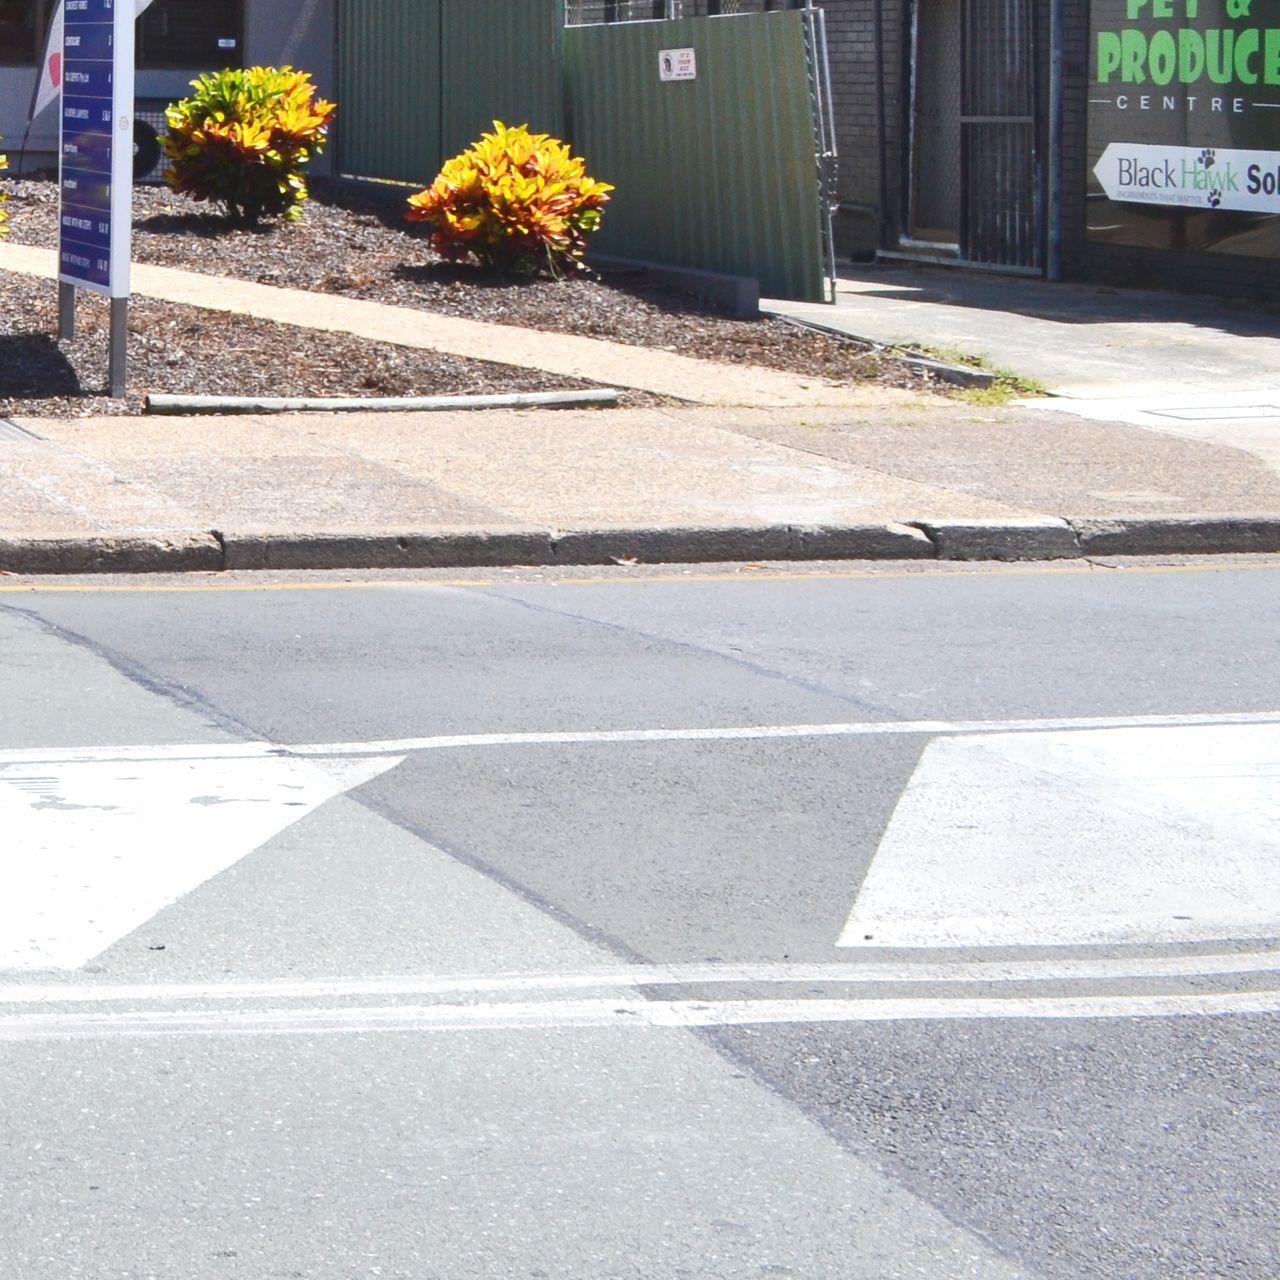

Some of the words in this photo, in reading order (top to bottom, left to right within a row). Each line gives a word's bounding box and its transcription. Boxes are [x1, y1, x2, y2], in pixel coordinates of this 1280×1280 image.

[1097, 28, 1280, 86] PRODUCE
[1116, 95, 1244, 113] CENTRE
[1117, 157, 1177, 189] Black
[1181, 158, 1240, 192] Hawk
